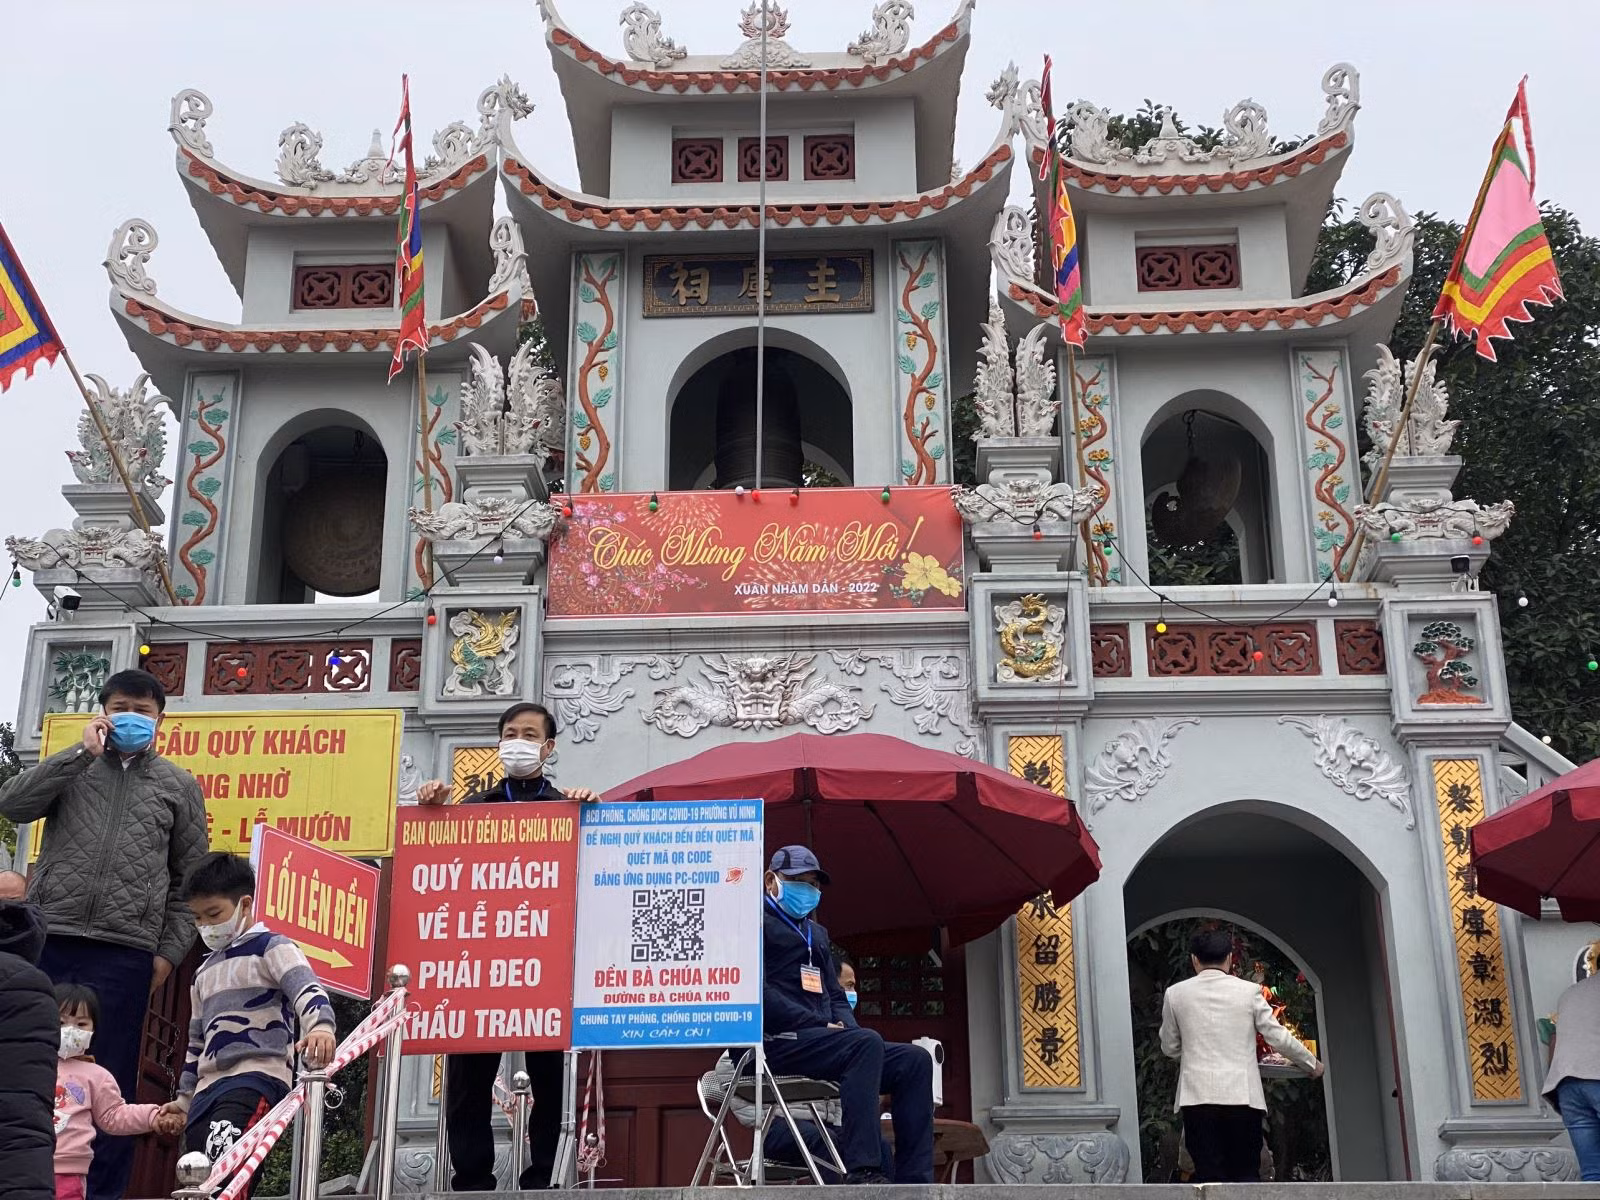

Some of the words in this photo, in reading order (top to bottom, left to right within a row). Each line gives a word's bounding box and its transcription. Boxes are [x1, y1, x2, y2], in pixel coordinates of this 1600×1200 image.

[588, 525, 654, 570] Chúc
[661, 525, 746, 581] Mừng
[753, 523, 830, 564] Năm
[734, 581, 769, 596] XUÂN
[772, 582, 809, 595] NHÂM
[812, 578, 839, 594] DẦN
[848, 582, 878, 593] 2022
[207, 725, 257, 759] QUÝ
[262, 724, 347, 755] KHÁCH
[237, 767, 292, 799] NHỜ
[276, 811, 351, 842] MƯỚN
[627, 804, 650, 821] CHỐNG
[651, 807, 667, 824] DỊCH
[668, 807, 699, 821] COVID-19
[700, 803, 727, 820] PHƯỜNG
[739, 805, 756, 819] NINH
[402, 820, 426, 846] BAN
[428, 812, 459, 848] QUẢN
[460, 815, 474, 844] LÝ
[476, 811, 499, 845] ĐỀN
[501, 814, 516, 844] BÀ
[518, 813, 548, 843] CHÚA
[550, 817, 573, 842] KHO
[600, 831, 622, 849] NGHỊ
[624, 830, 641, 846] QUÝ
[643, 829, 673, 845] KHÁCH
[715, 827, 738, 843] QUÉT
[627, 849, 651, 866] QUÉT
[653, 849, 669, 864] MÃ
[672, 851, 684, 865] QR
[687, 850, 712, 864] CODE
[412, 857, 464, 894] QUÝ
[470, 855, 560, 890] KHÁCH
[623, 869, 643, 886] ỨNG
[646, 872, 672, 888] DỤNG
[675, 871, 720, 885] PC-COVID
[265, 850, 297, 924] LỐI
[297, 868, 332, 937] LÊN
[333, 877, 368, 949] ĐỀN
[417, 901, 450, 940] VỀ
[457, 901, 489, 939] LỄ
[495, 900, 549, 938] ĐỀN
[418, 950, 481, 990] PHẢI
[489, 958, 541, 989] ĐEO
[594, 964, 627, 988] ĐỀN
[632, 965, 654, 987] BÀ
[659, 964, 705, 986] CHÚA
[708, 967, 741, 986] KHO
[603, 990, 646, 1004] ĐƯỜNG
[650, 990, 666, 1003] BÀ
[669, 990, 702, 1003] CHÚA
[705, 991, 730, 1002] KHO
[474, 1008, 562, 1038] TRANG
[580, 1014, 609, 1025] CHUNG
[611, 1014, 626, 1025] TAY
[628, 1011, 659, 1025] PHÒNG,
[661, 1011, 690, 1023] CHỐNG
[692, 1012, 712, 1025] DỊCH
[714, 1011, 753, 1022] COVID-19
[621, 1029, 644, 1039] XIN
[649, 1026, 680, 1038] CẢM
